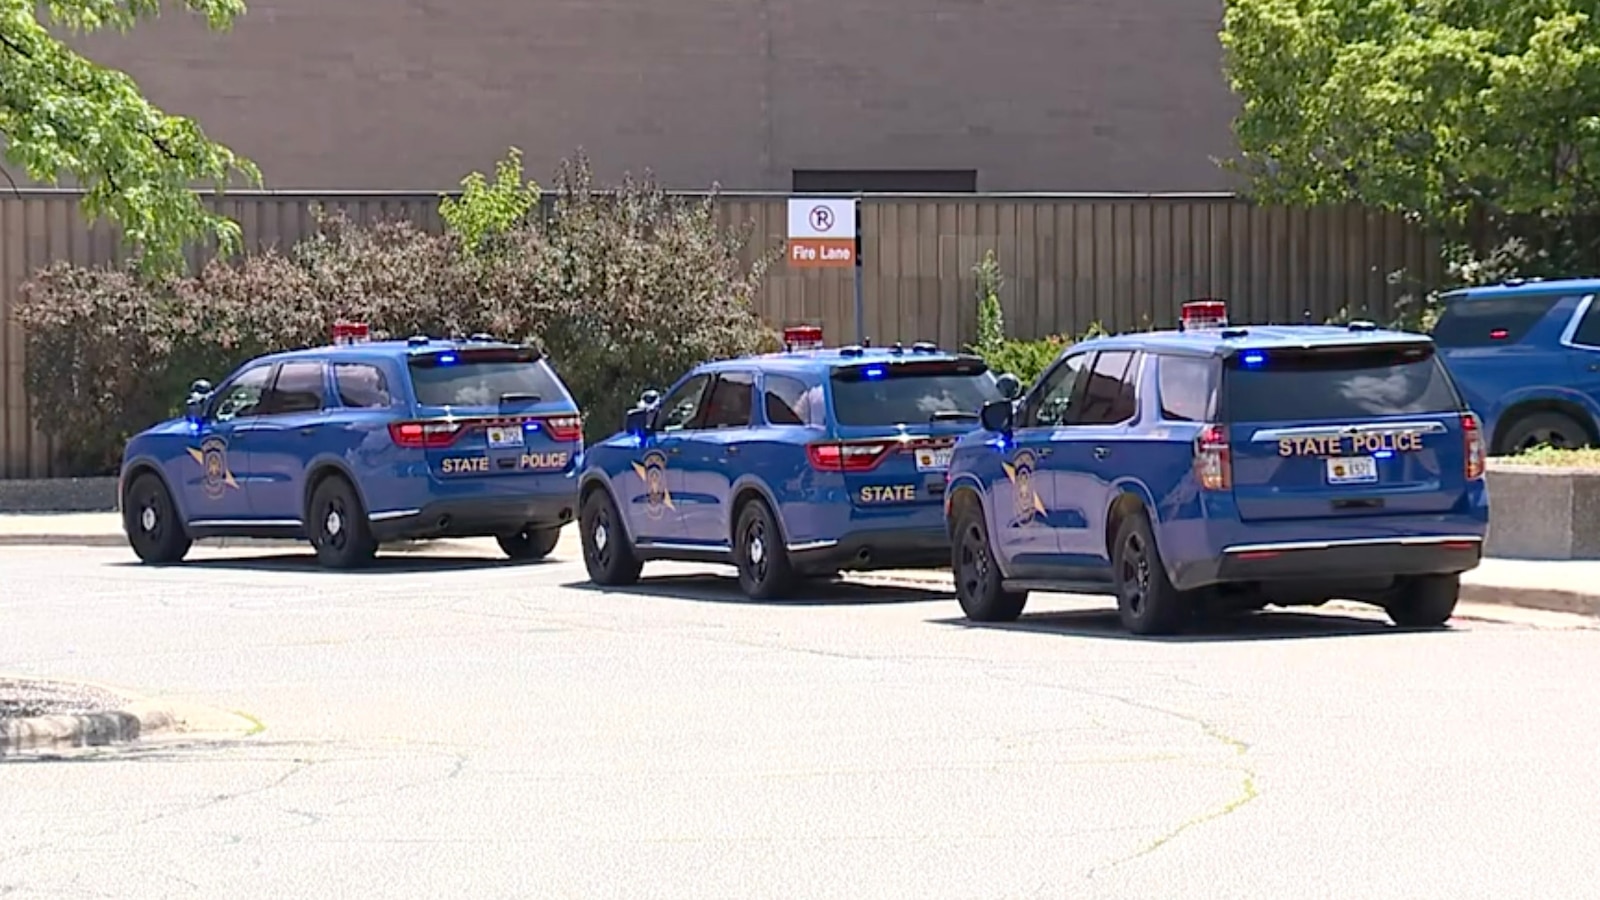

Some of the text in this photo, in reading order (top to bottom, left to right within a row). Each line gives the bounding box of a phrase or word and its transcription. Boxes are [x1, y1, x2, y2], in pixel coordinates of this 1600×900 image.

[793, 245, 851, 260] Fire Lane
[1278, 433, 1423, 456] STATE POLICE
[442, 453, 567, 473] STATE POLICE
[861, 485, 916, 502] STATE
